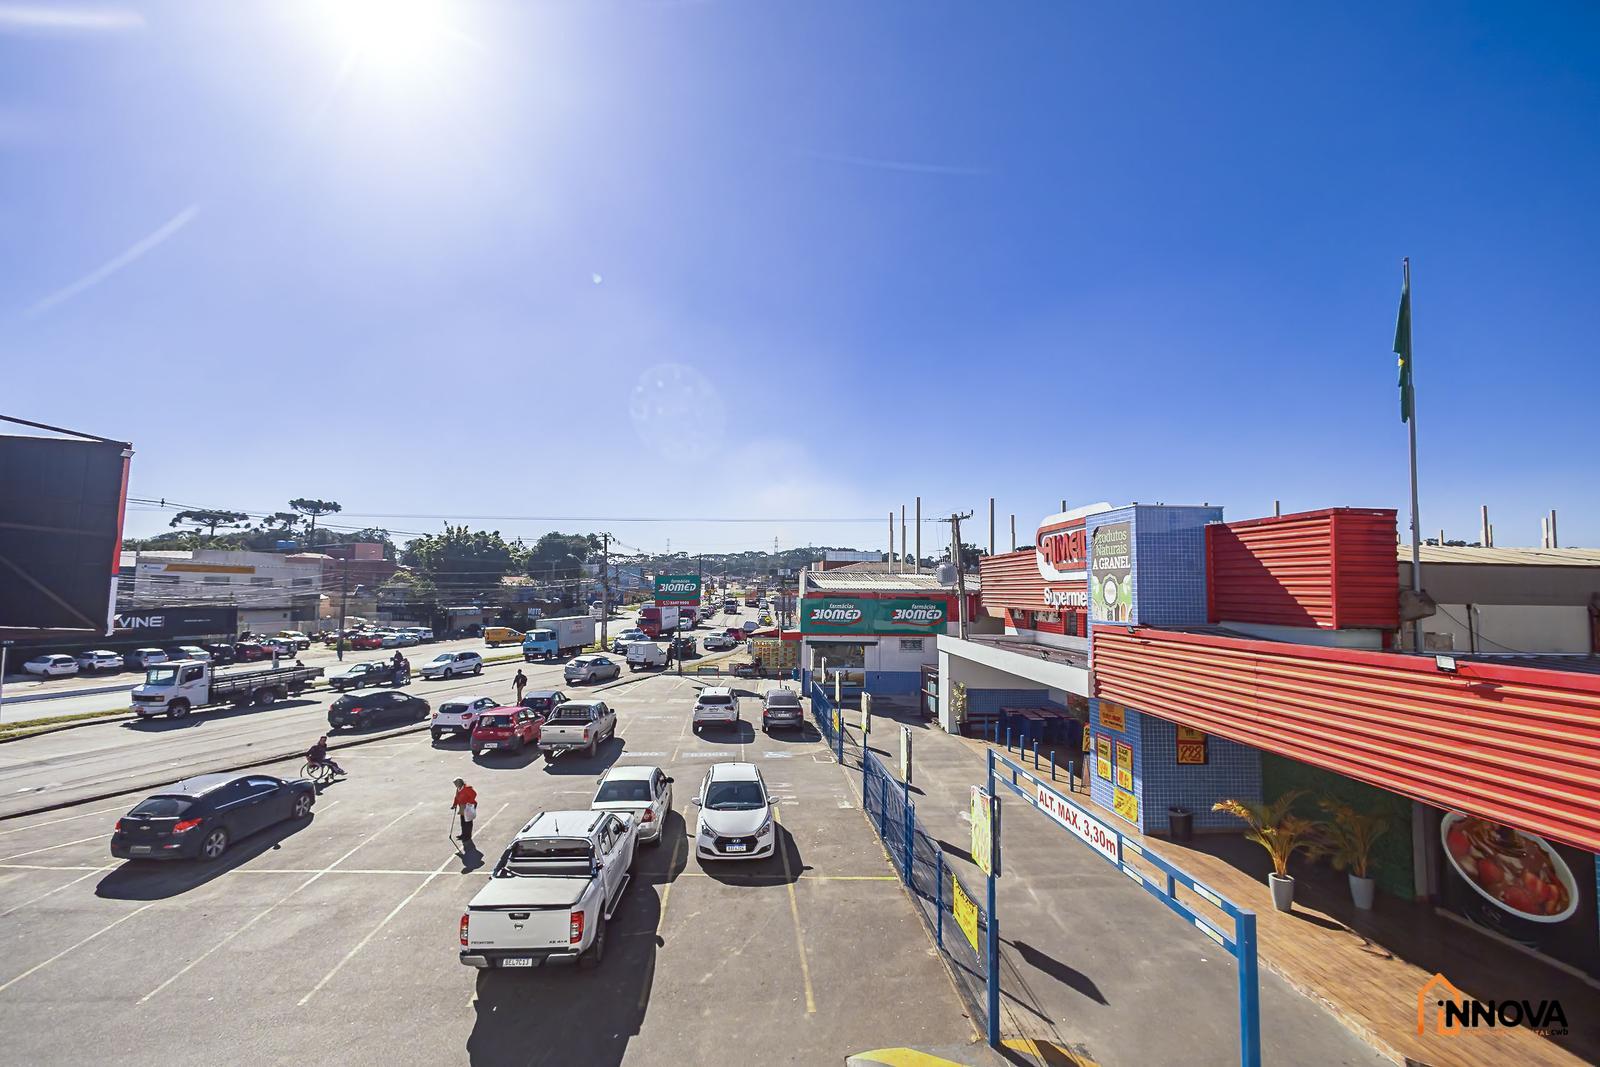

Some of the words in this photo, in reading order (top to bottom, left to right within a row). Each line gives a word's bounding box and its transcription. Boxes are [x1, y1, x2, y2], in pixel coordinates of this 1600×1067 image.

[1096, 542, 1127, 556] Naturais
[1092, 558, 1099, 570] A
[1099, 556, 1131, 569] GRANEL
[658, 583, 697, 592] BIOMED
[810, 609, 862, 620] BIOMED
[892, 609, 943, 620] BIOMED
[1039, 790, 1056, 813] ALT.
[1057, 801, 1081, 831] MAX.
[1083, 819, 1117, 856] 3,30m
